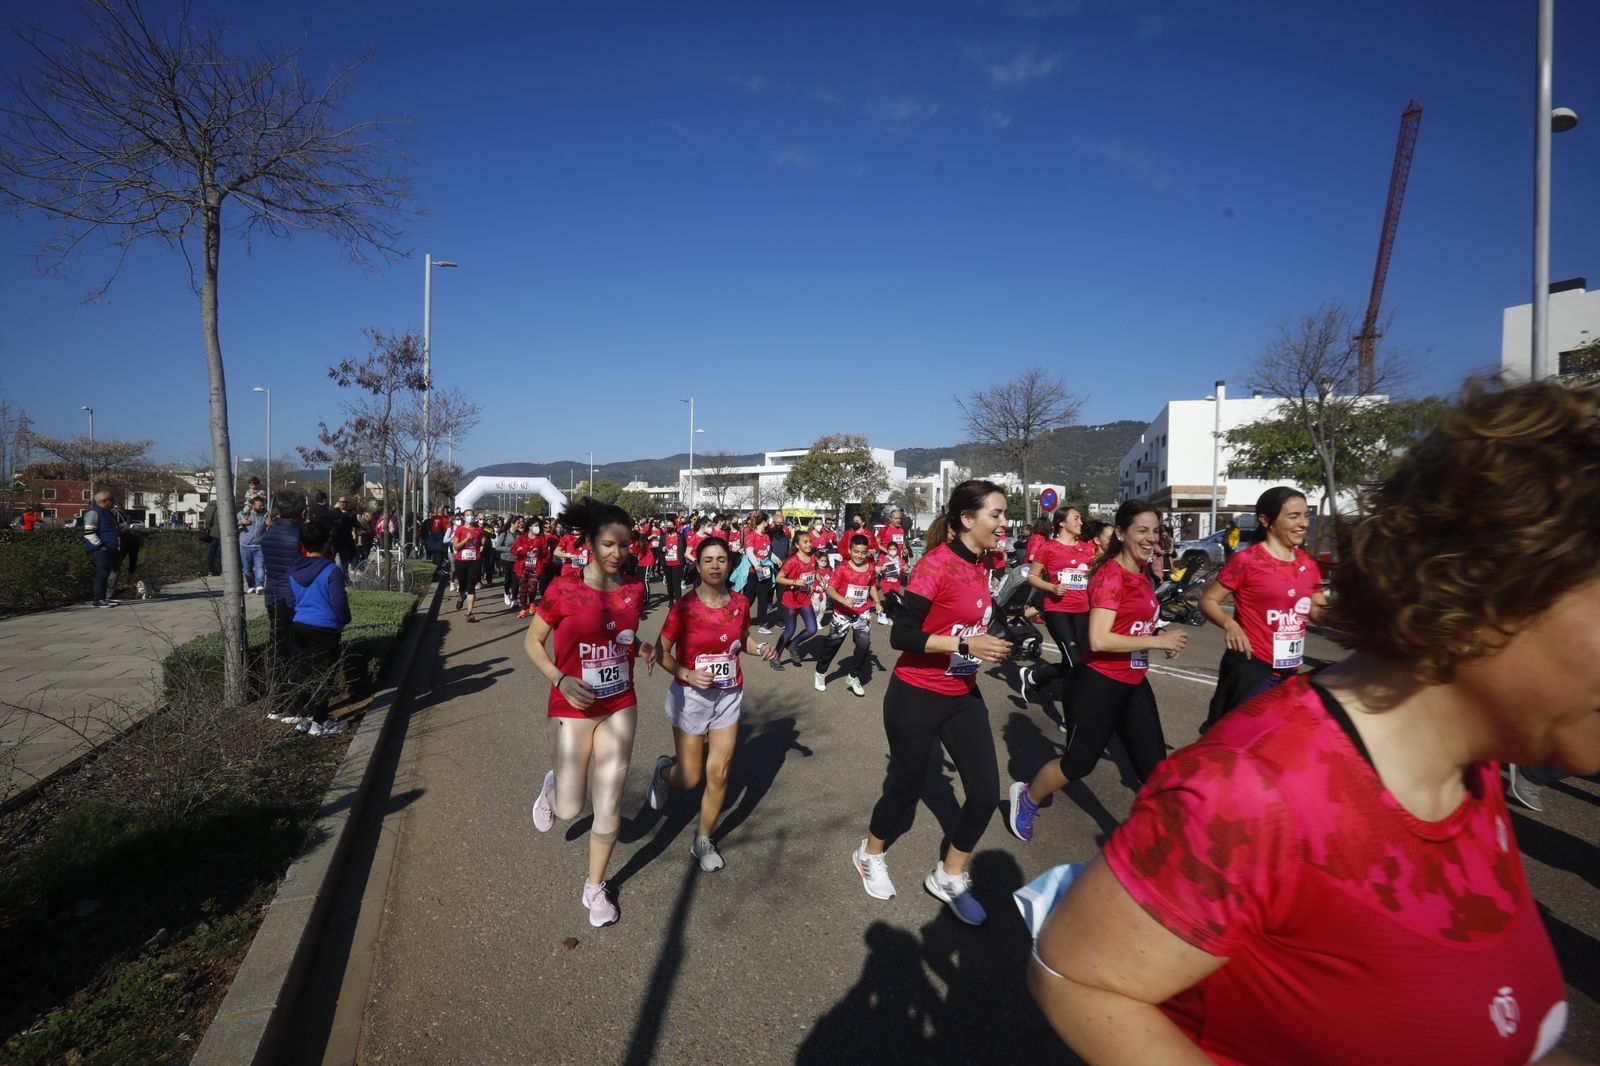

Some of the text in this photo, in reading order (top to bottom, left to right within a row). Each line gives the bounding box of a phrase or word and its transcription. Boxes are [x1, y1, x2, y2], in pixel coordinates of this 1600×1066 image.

[1070, 573, 1082, 582] 185
[1267, 608, 1299, 626] Pink
[579, 640, 618, 659] Pink
[598, 666, 620, 683] 125
[709, 662, 730, 676] 126
